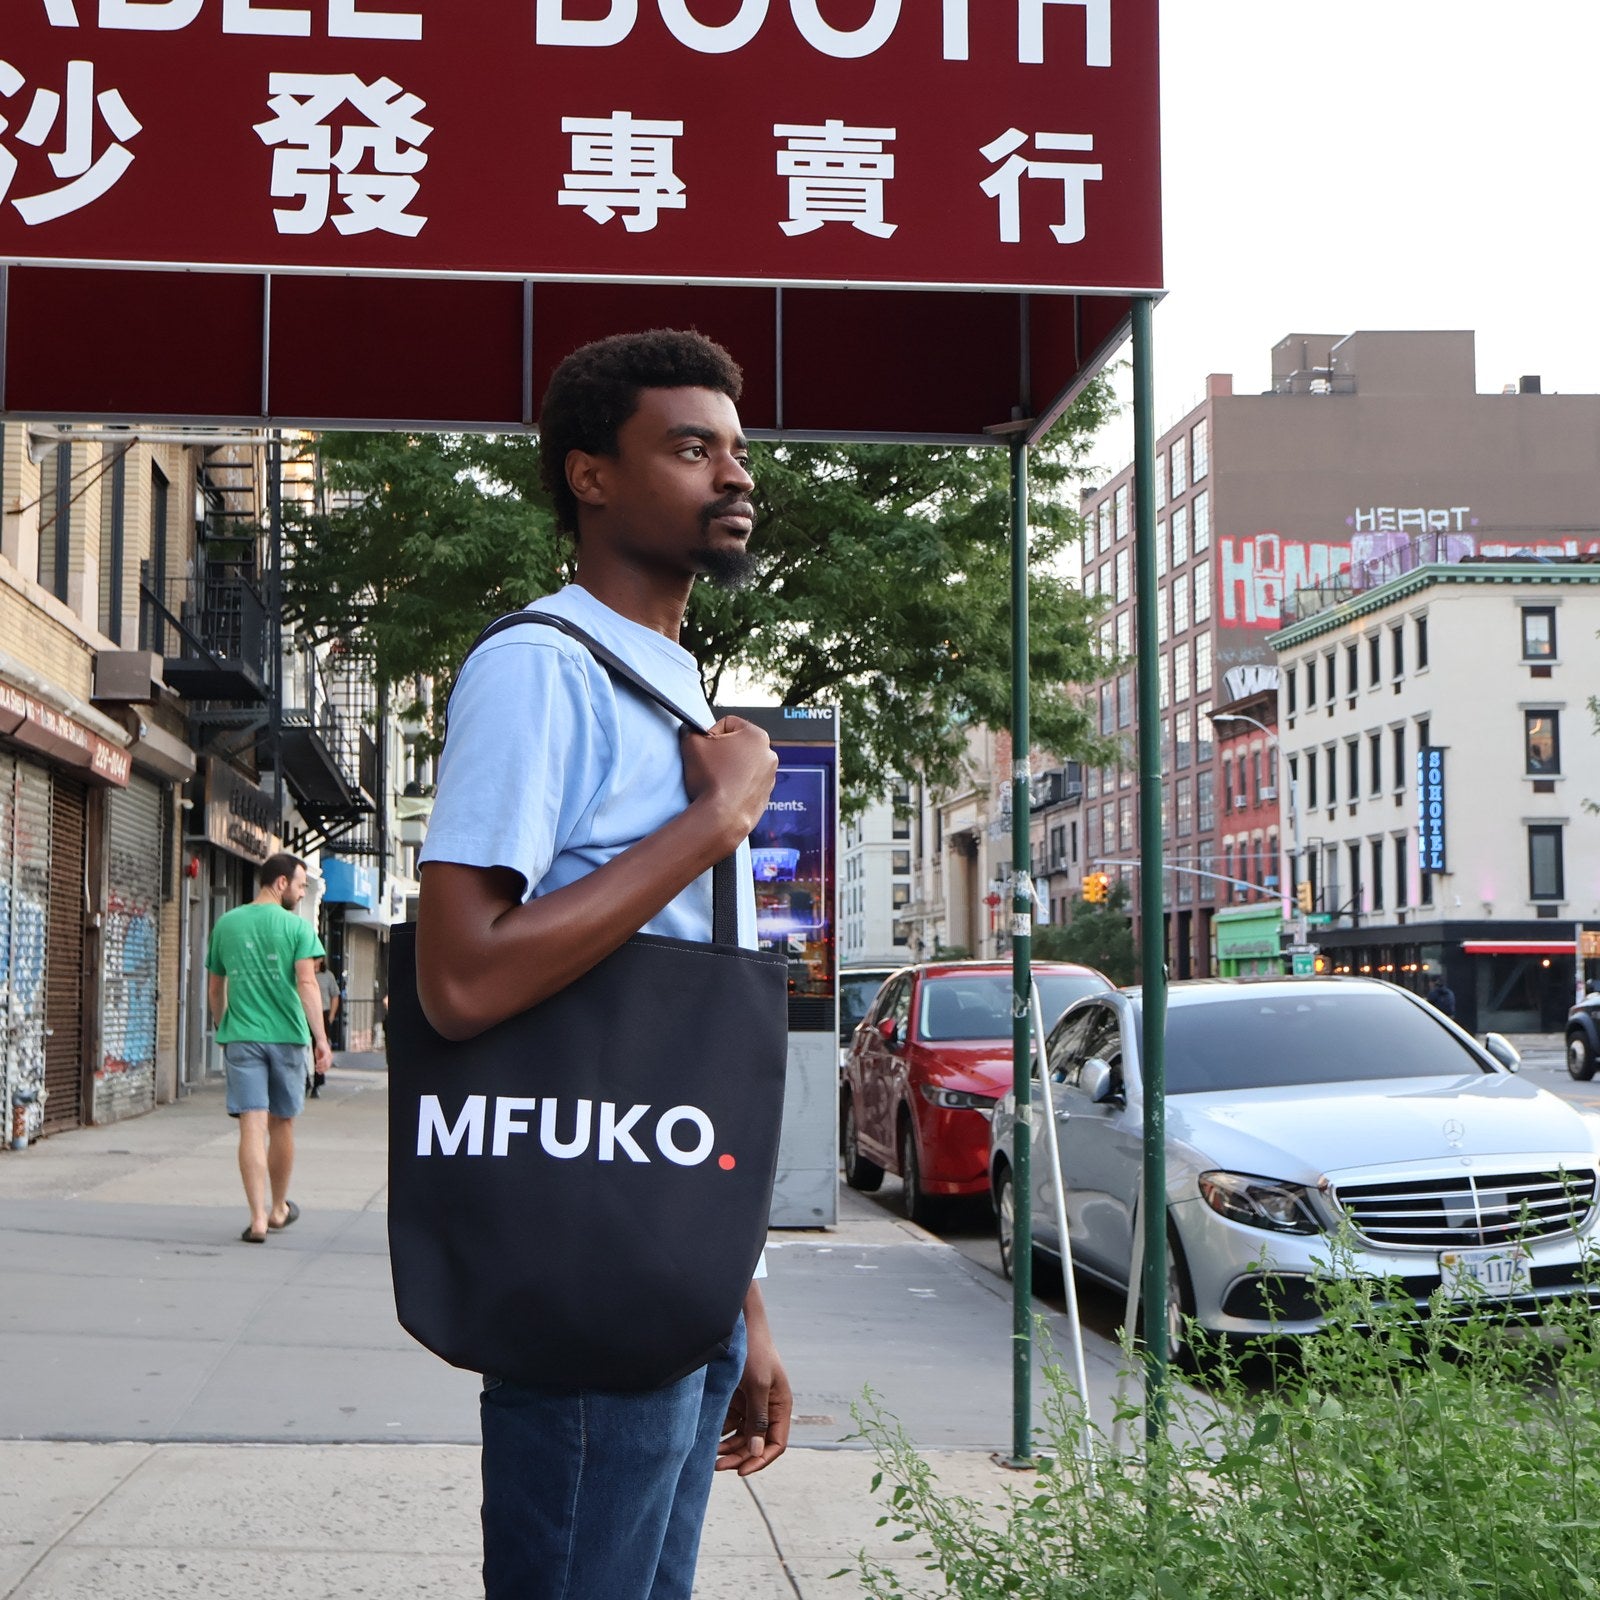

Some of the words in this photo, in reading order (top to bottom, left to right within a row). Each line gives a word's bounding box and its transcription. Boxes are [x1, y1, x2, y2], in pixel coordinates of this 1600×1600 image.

[0, 60, 1103, 244] 沙發專賣行
[783, 708, 833, 720] LinkNYC
[766, 800, 807, 811] ments.
[1428, 751, 1443, 868] SOHOTEL
[416, 1094, 736, 1171] MFUKO.
